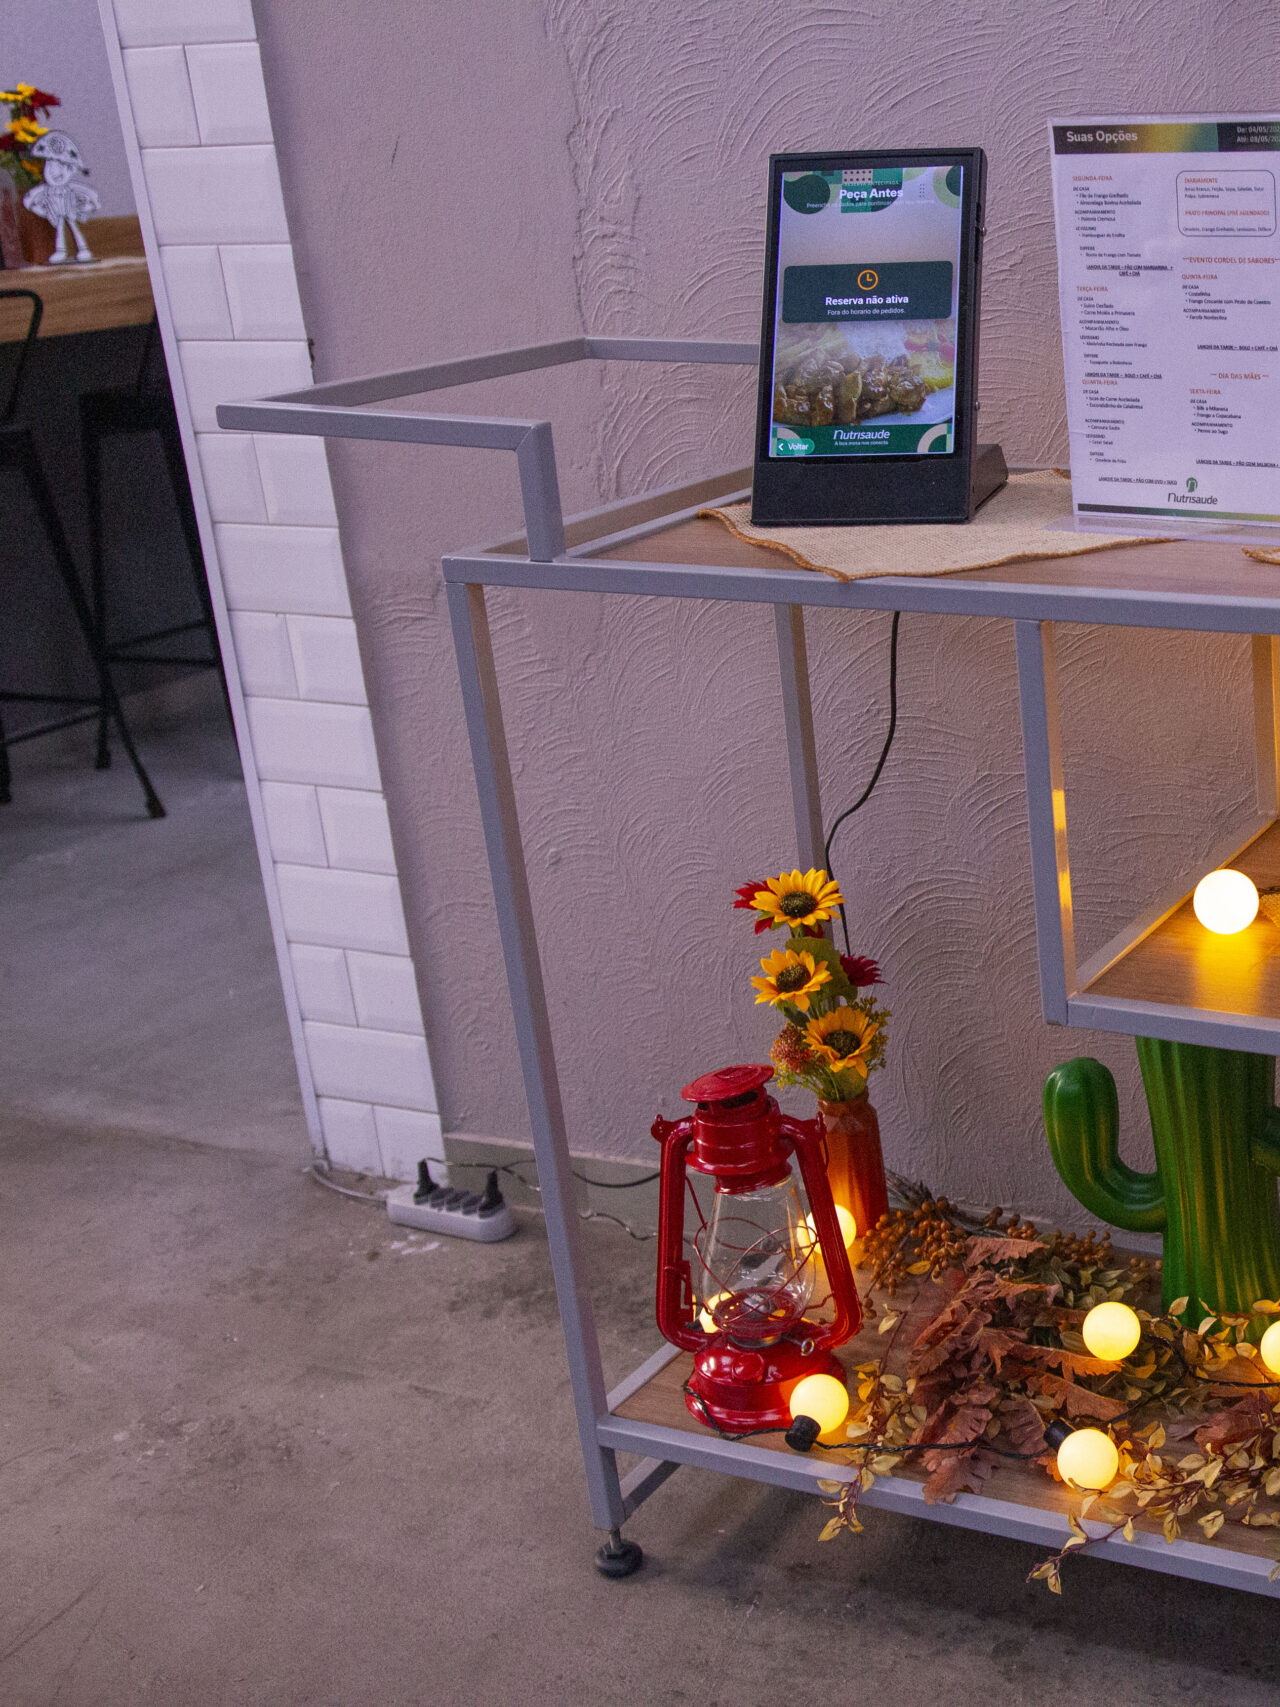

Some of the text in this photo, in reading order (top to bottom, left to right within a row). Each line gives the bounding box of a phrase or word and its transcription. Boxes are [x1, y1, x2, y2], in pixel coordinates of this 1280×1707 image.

[1066, 130, 1138, 143] Suas Opções
[840, 188, 904, 200] Peça Antes
[825, 294, 909, 306] Reserva não ativa
